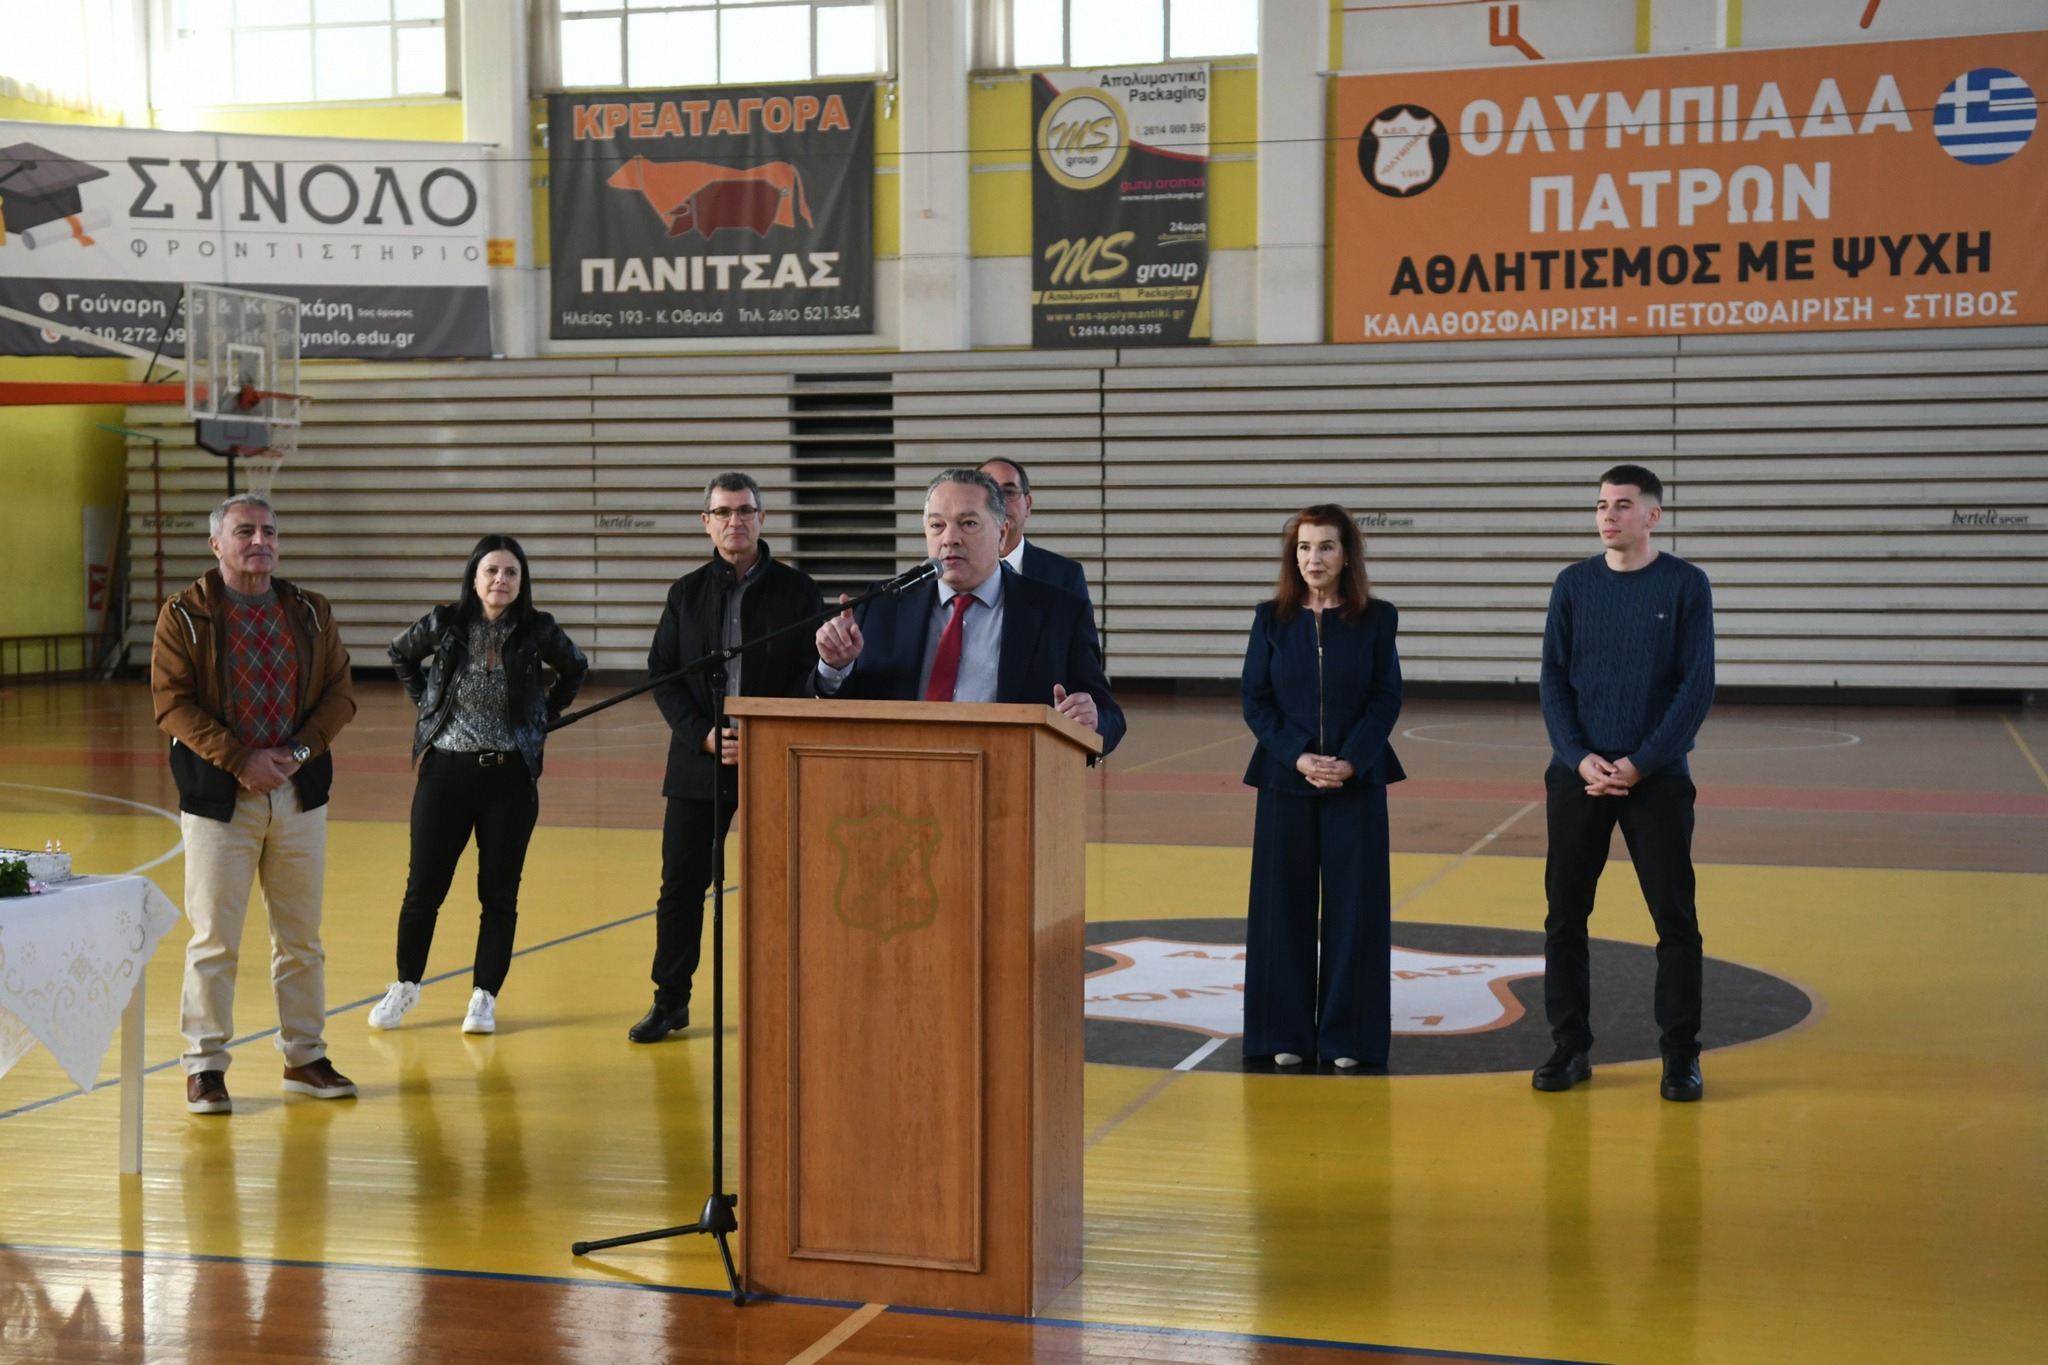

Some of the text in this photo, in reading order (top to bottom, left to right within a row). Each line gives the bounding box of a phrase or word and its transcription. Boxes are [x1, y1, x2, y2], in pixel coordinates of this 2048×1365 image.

[1100, 66, 1206, 87] Απολυμαντική
[1128, 86, 1206, 103] Packaging
[573, 94, 850, 140] ΚΡΕΑΤΑΓΟΡΑ
[1458, 73, 1914, 156] ΟΛΥΜΠΙΑΔΑ
[1049, 116, 1114, 156] MS
[1066, 156, 1098, 168] group
[127, 156, 478, 228] ΣΥΝΟΛΟ
[1528, 161, 1832, 234] ΠΑΤΡΩΝ
[130, 238, 480, 262] ΦΡΟΝΤΙΣΤΗΡΙΟ
[1044, 231, 1199, 285] MS group
[1388, 230, 1992, 296] ΑΘΛΗΤΙΣΜΟΣ ΜΕ ΨΥΧΗ
[580, 251, 841, 294] ΠΑΝΙΤΣΑΣ
[65, 293, 167, 318] Γούναρη
[1137, 287, 1192, 300] Packaging
[562, 310, 612, 327] Ηλείας
[618, 310, 644, 324] 193
[768, 308, 800, 322] 2610
[803, 305, 861, 321] 521.354
[1078, 323, 1162, 337] 2614.000.595
[1363, 306, 1618, 338] ΚΑΛΑΘΟΣΦΑΙΡΙΣΗ
[1646, 296, 1873, 329] ΠΕΤΟΣΦΑΙΡΙΣΗ
[1904, 290, 2018, 319] ΣΤΙΒΟΣ
